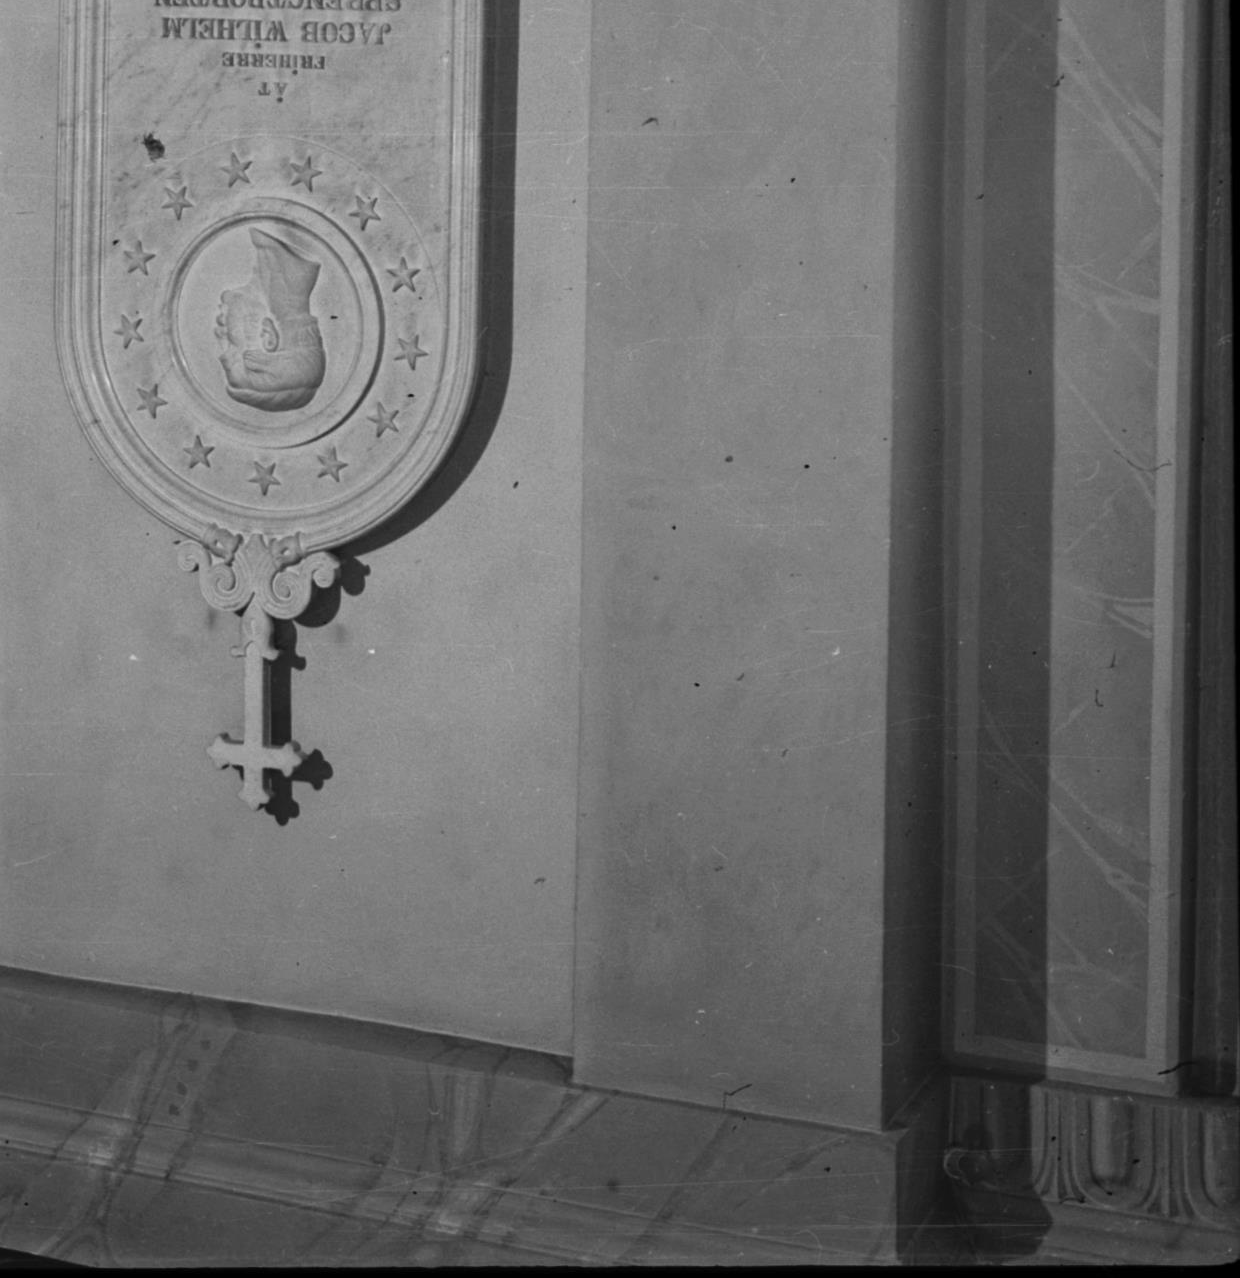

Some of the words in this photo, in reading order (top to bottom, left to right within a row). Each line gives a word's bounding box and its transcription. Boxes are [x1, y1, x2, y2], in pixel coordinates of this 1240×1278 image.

[161, 18, 287, 49] WILHELM
[301, 21, 392, 46] JACOB
[221, 52, 326, 75] FRIHERRE
[257, 81, 288, 103] ÅT
